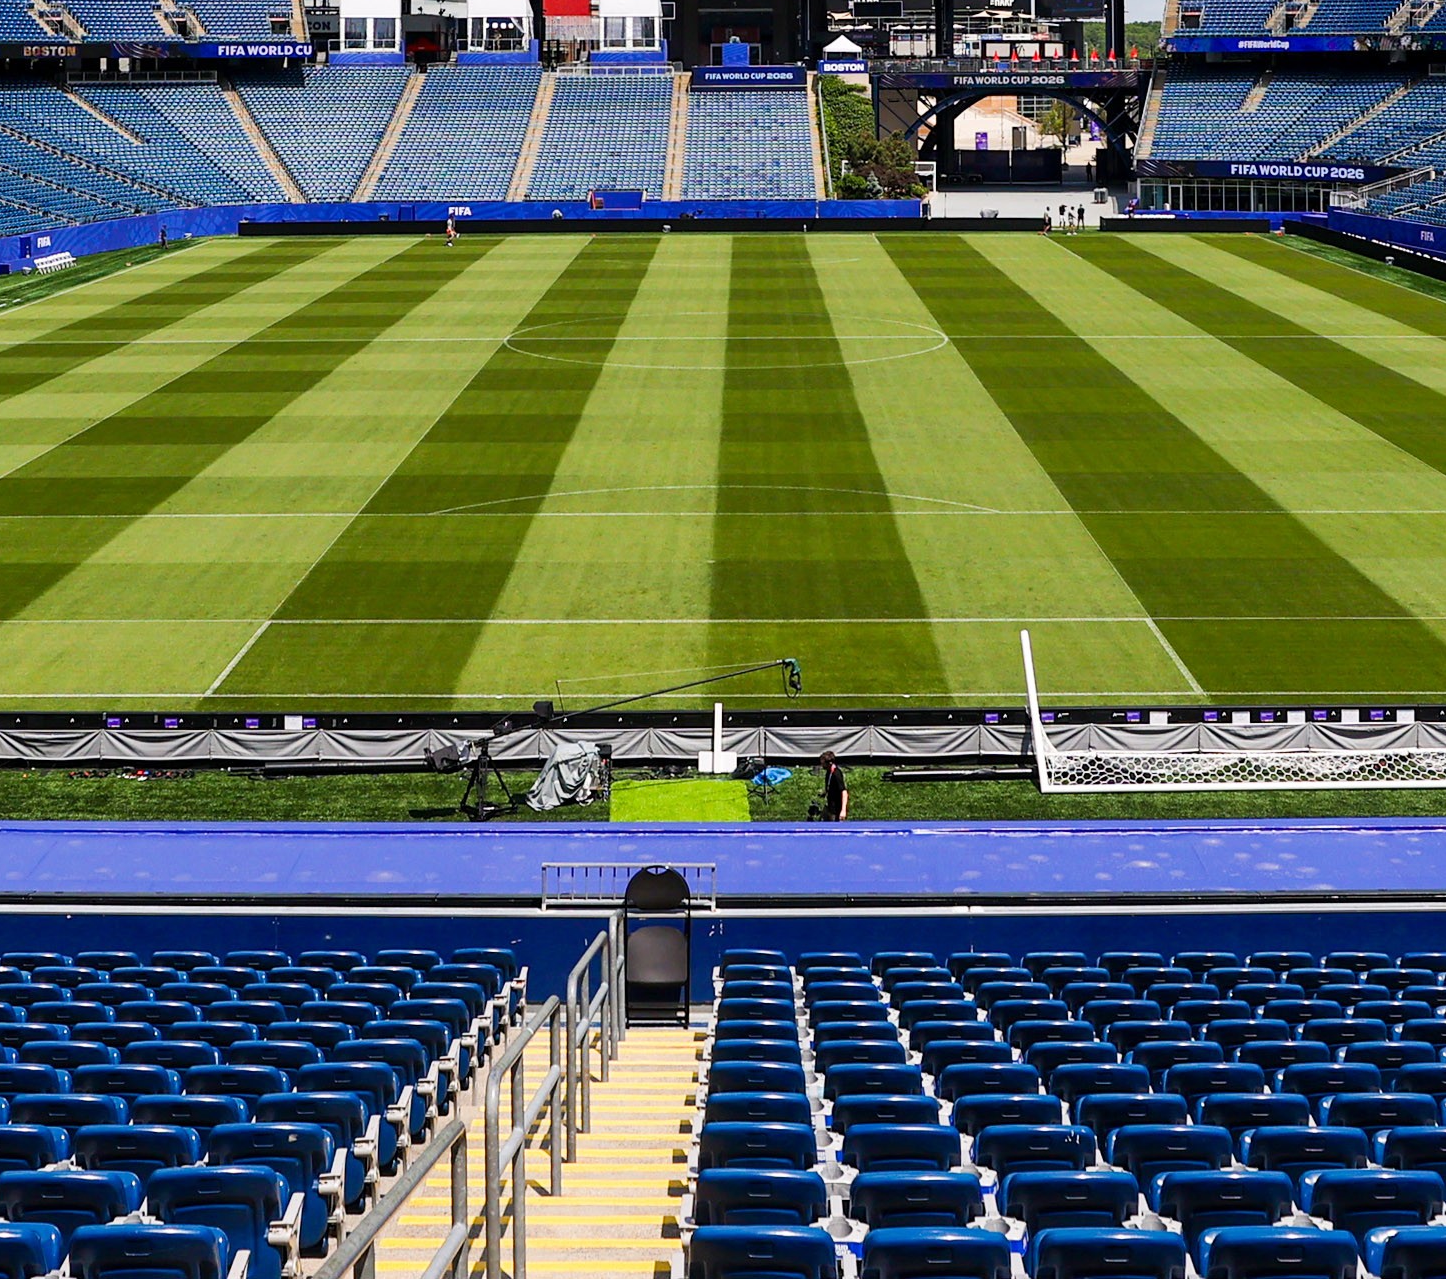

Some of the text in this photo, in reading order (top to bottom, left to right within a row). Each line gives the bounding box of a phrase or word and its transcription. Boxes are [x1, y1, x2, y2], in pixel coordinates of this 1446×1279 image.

[218, 45, 245, 56] FIFA
[246, 45, 294, 56] WORLD
[1238, 39, 1290, 51] #FIFAWorldCup
[23, 46, 77, 57] BOSTON
[823, 63, 865, 72] BOSTON
[705, 72, 794, 80] FIFA WORLD CUP 2026
[953, 75, 1065, 85] FIFA WORLD CUP 2026
[1230, 164, 1364, 180] FIFA WORLD CUP 2026
[448, 206, 473, 216] FIFA
[37, 235, 52, 249] FIFA
[1420, 230, 1435, 243] FIFA
